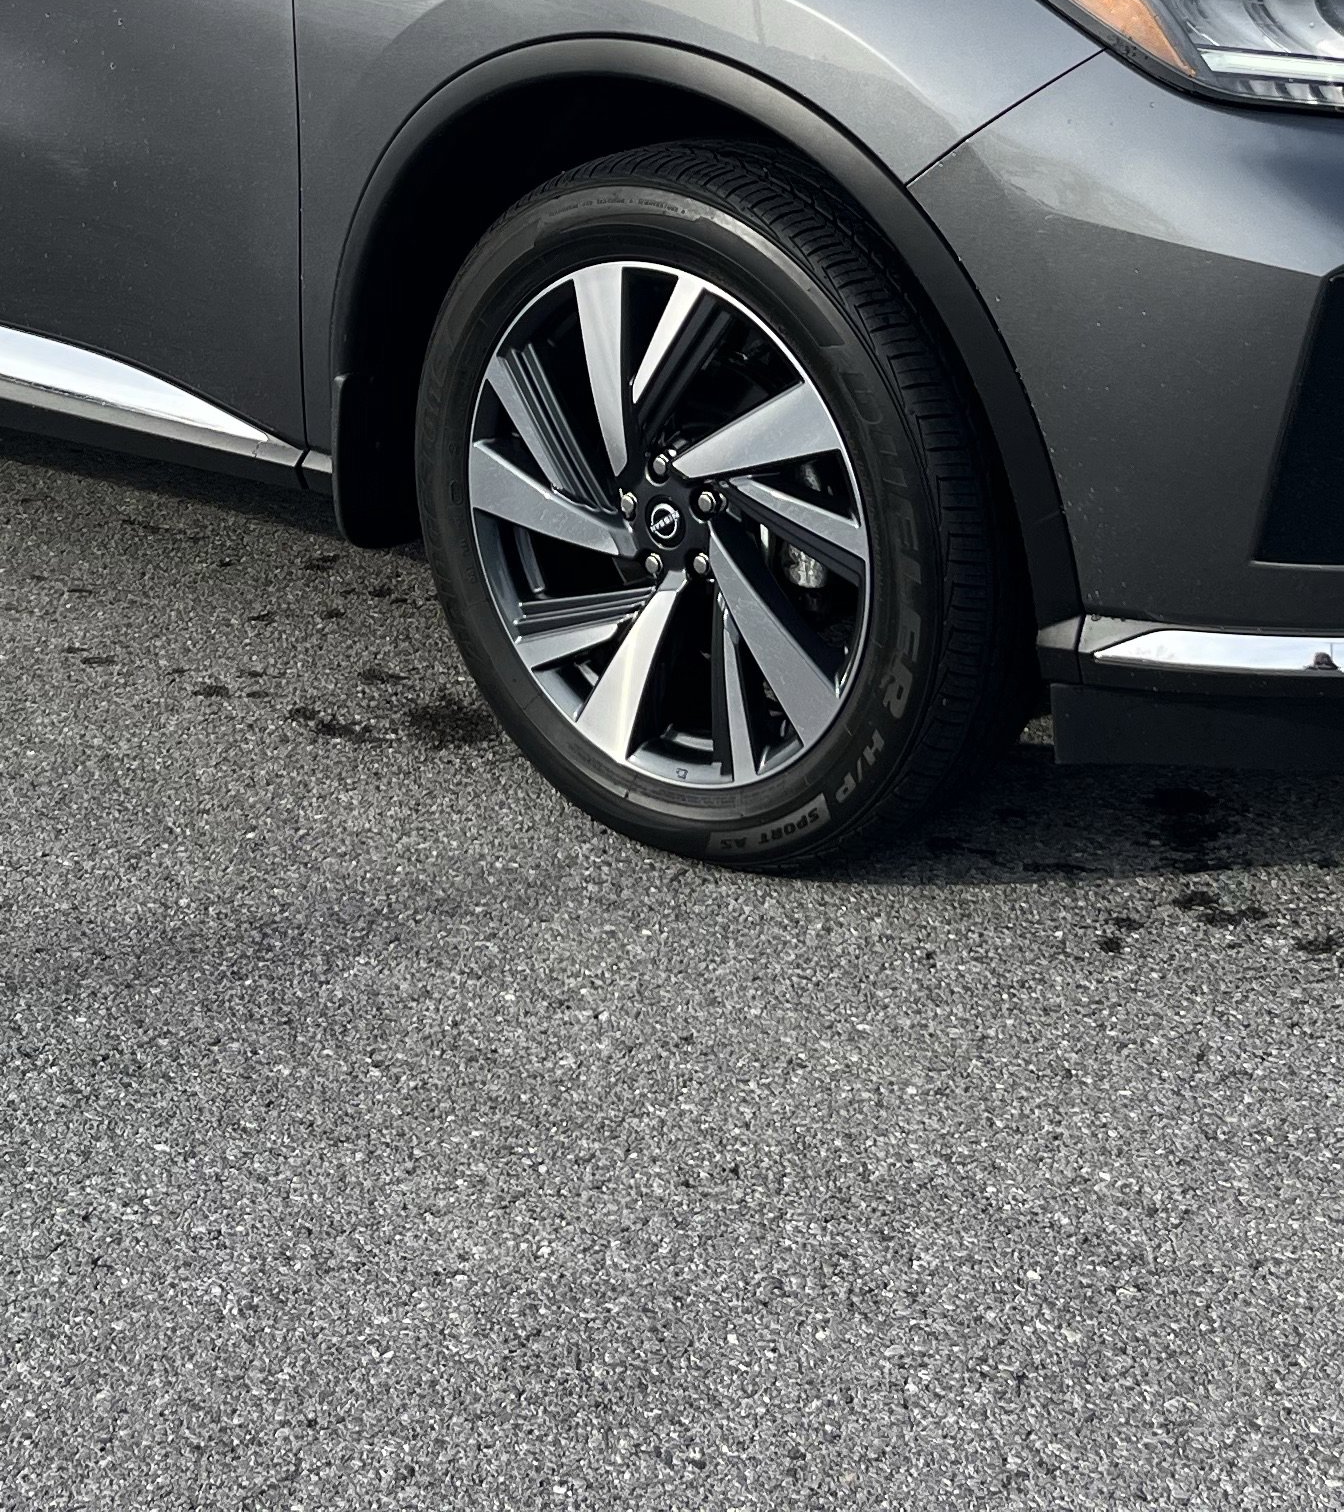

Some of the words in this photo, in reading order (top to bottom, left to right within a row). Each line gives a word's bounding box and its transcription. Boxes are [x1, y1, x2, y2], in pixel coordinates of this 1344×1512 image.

[835, 729, 885, 803] H/P
[721, 837, 747, 850] AS
[758, 807, 819, 845] SPORT
